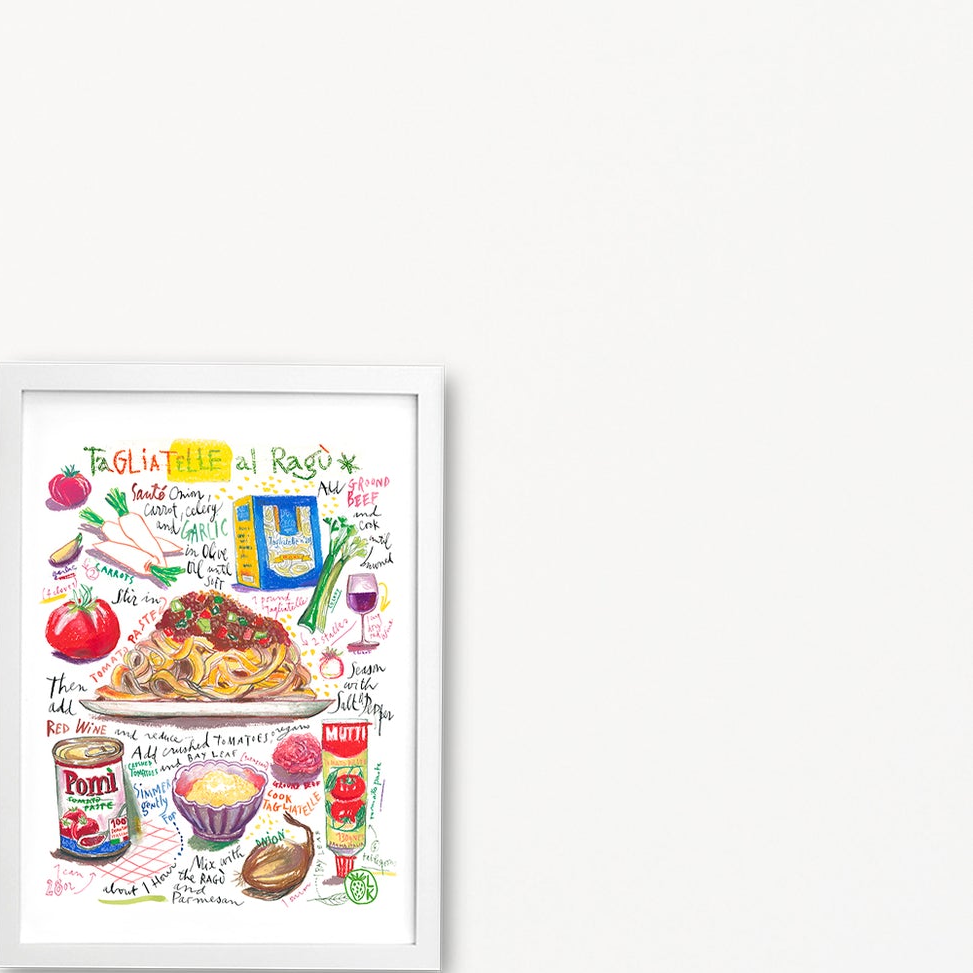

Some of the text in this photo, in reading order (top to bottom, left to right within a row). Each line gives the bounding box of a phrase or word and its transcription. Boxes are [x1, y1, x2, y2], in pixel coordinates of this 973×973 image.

[236, 447, 257, 475] al
[270, 443, 333, 480] Ragù
[347, 490, 380, 509] BEEF
[352, 504, 382, 518] and
[156, 518, 228, 544] and GARLIC
[369, 531, 393, 550] until
[185, 544, 199, 558] in
[95, 562, 135, 585] CARROTS
[207, 560, 233, 576] until
[111, 586, 163, 607] Stir in
[89, 611, 159, 684] TOMATO PASTE
[311, 637, 320, 647] 2
[347, 660, 386, 679] Season
[46, 672, 89, 699] Then
[343, 677, 379, 691] with
[48, 698, 78, 716] add
[327, 690, 360, 714] Salt
[358, 692, 395, 737] Pepper
[46, 719, 70, 738] RED
[114, 728, 139, 741] and
[325, 725, 367, 743] MUTTI
[161, 731, 211, 757] crushed
[159, 748, 238, 773] and BAY LEAF
[83, 800, 115, 812] PASTE
[140, 795, 169, 817] gently
[262, 791, 322, 817] TAGLIATELLE
[267, 789, 292, 804] COOK
[189, 844, 246, 872] Mix with
[178, 867, 226, 885] the RAGÙ
[102, 882, 139, 897] about
[141, 880, 150, 894] 1
[173, 883, 206, 895] and
[171, 890, 245, 907] Parmesan
